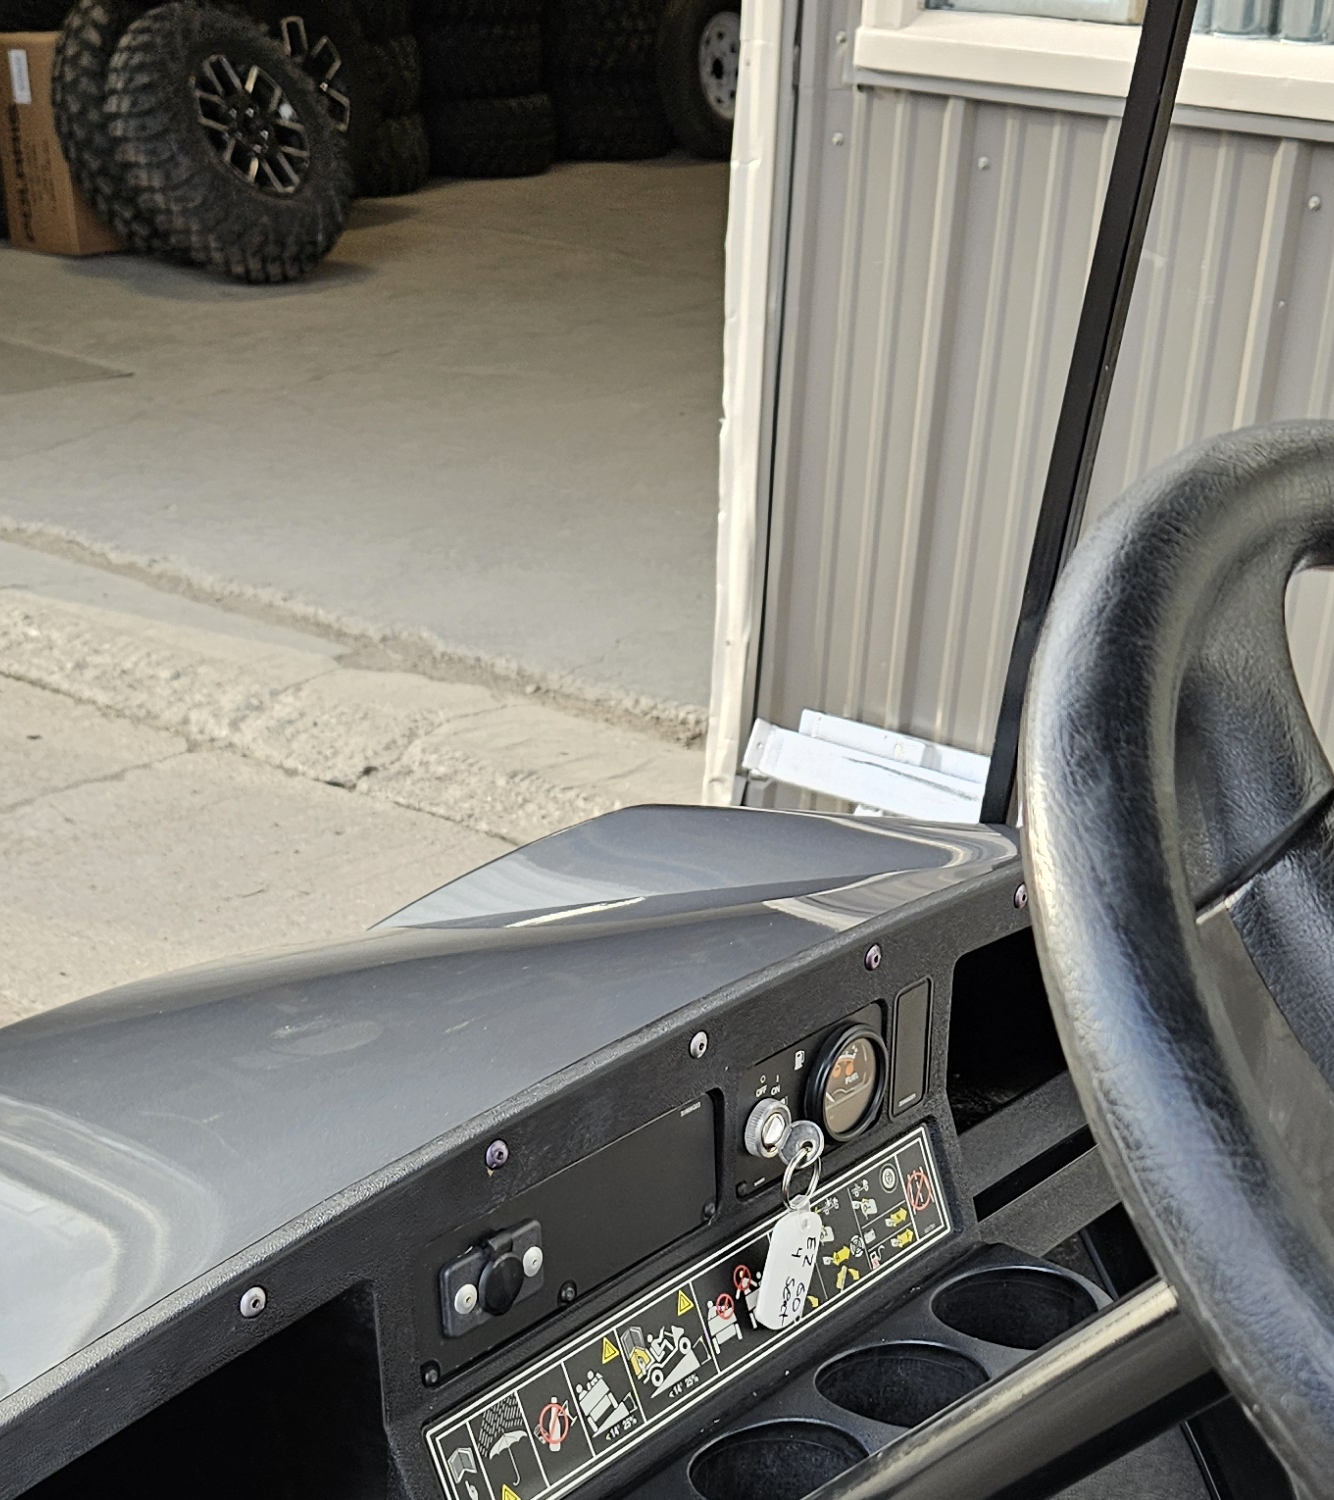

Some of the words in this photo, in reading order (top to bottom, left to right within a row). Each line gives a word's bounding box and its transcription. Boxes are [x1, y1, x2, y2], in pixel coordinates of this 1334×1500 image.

[755, 1085, 767, 1097] OFF
[771, 1085, 780, 1095] ON
[791, 1247, 802, 1258] 4
[802, 1237, 816, 1267] EZ
[684, 1374, 699, 1388] 25%
[622, 1416, 637, 1430] 25%
